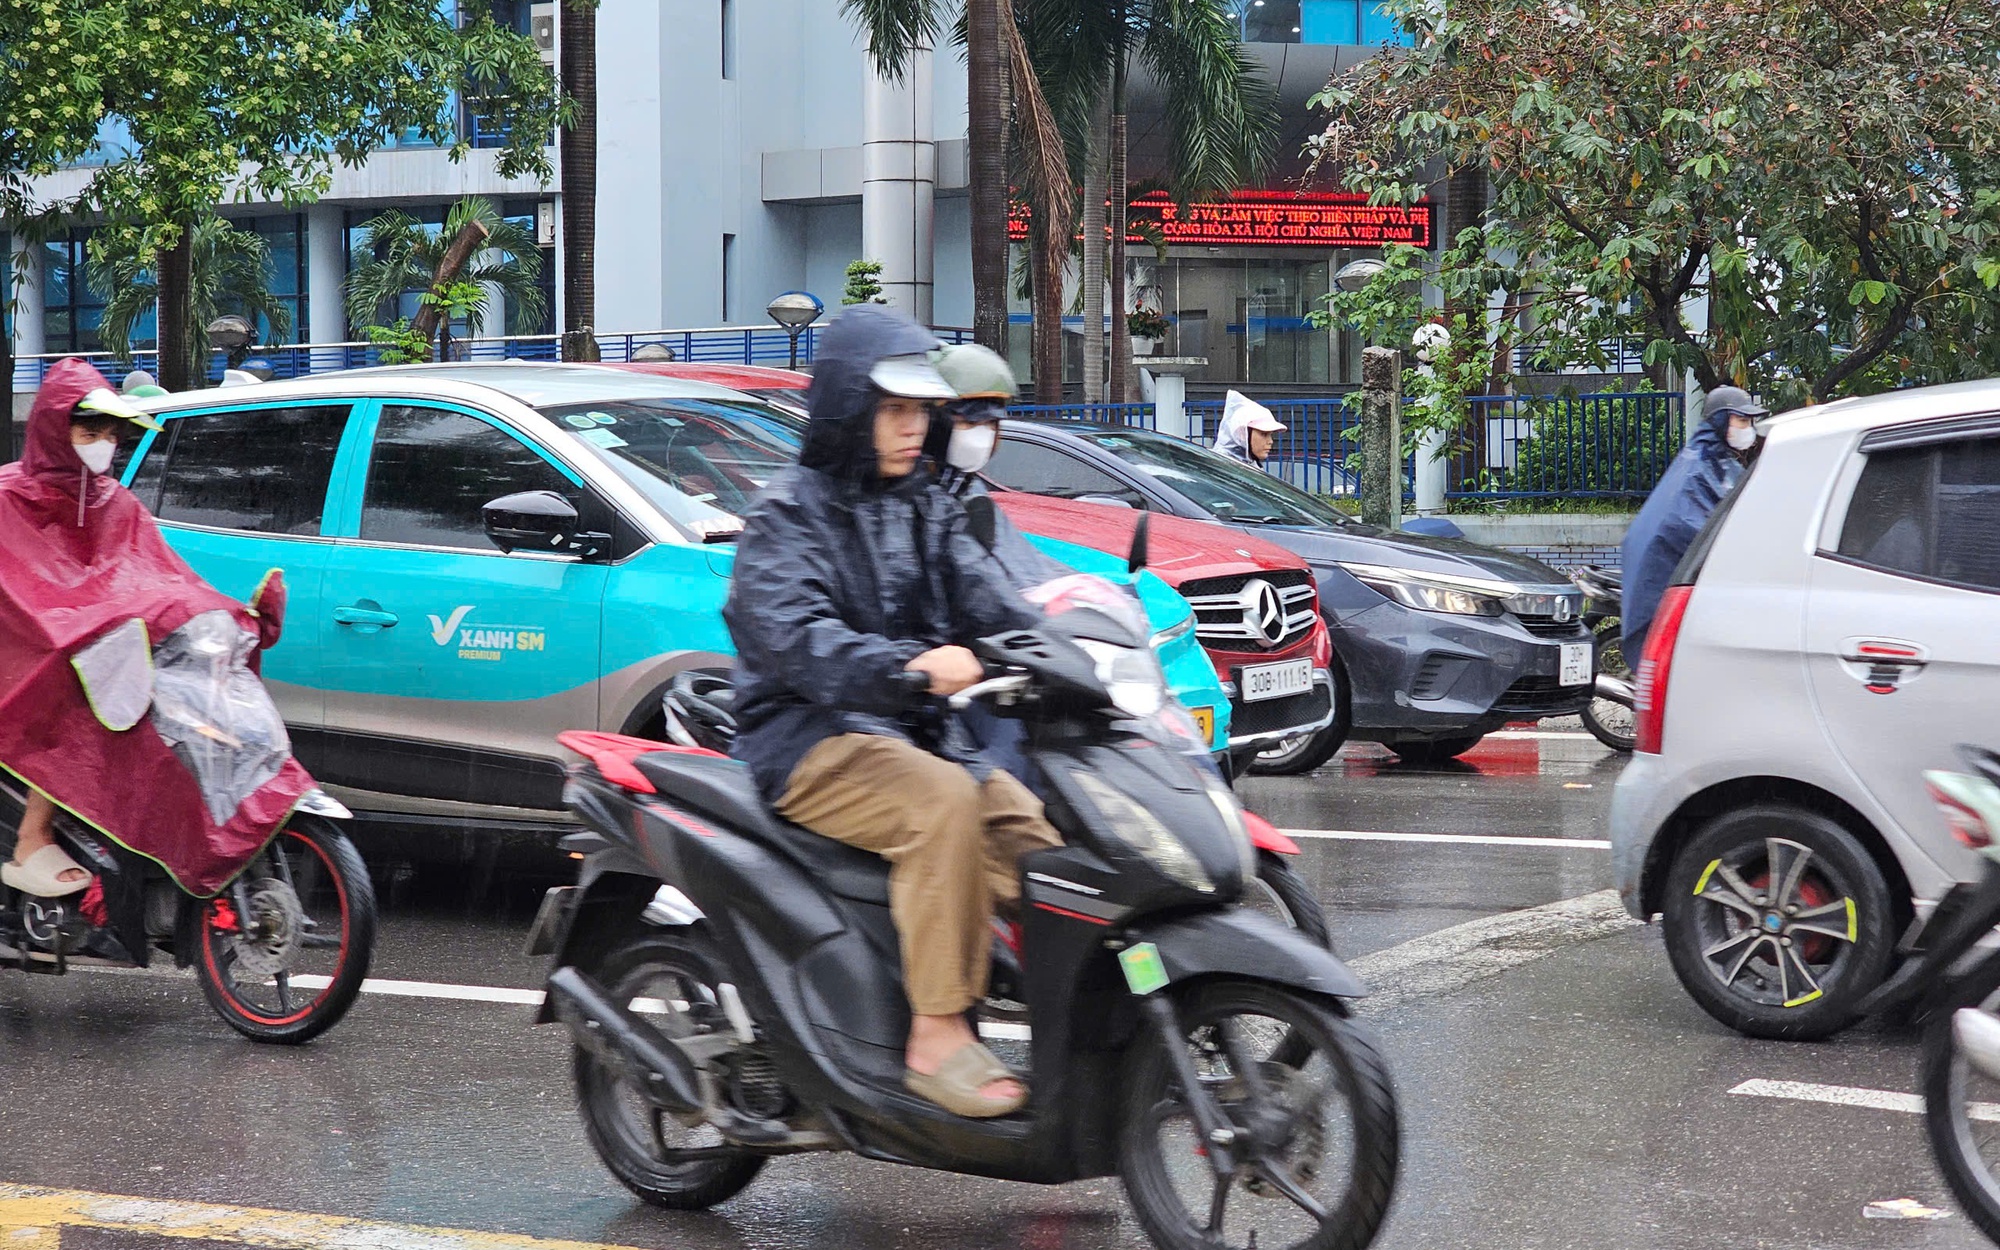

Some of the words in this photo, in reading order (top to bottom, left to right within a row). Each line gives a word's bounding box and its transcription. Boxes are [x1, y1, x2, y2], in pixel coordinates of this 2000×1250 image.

[1253, 208, 1284, 223] VIỆC
[1285, 210, 1319, 223] THEO
[1353, 208, 1387, 224] PHÁP
[1162, 220, 1201, 236] CỘNG
[1232, 222, 1253, 236] XÃ
[1254, 222, 1279, 237] HỘI
[1281, 222, 1307, 237] CHỦ
[1309, 223, 1350, 237] NGHĨA
[1351, 225, 1381, 239] VIỆT
[1382, 227, 1413, 239] NAM
[458, 629, 515, 649] XANH
[516, 631, 545, 651] SM
[458, 649, 501, 661] PREMIUM
